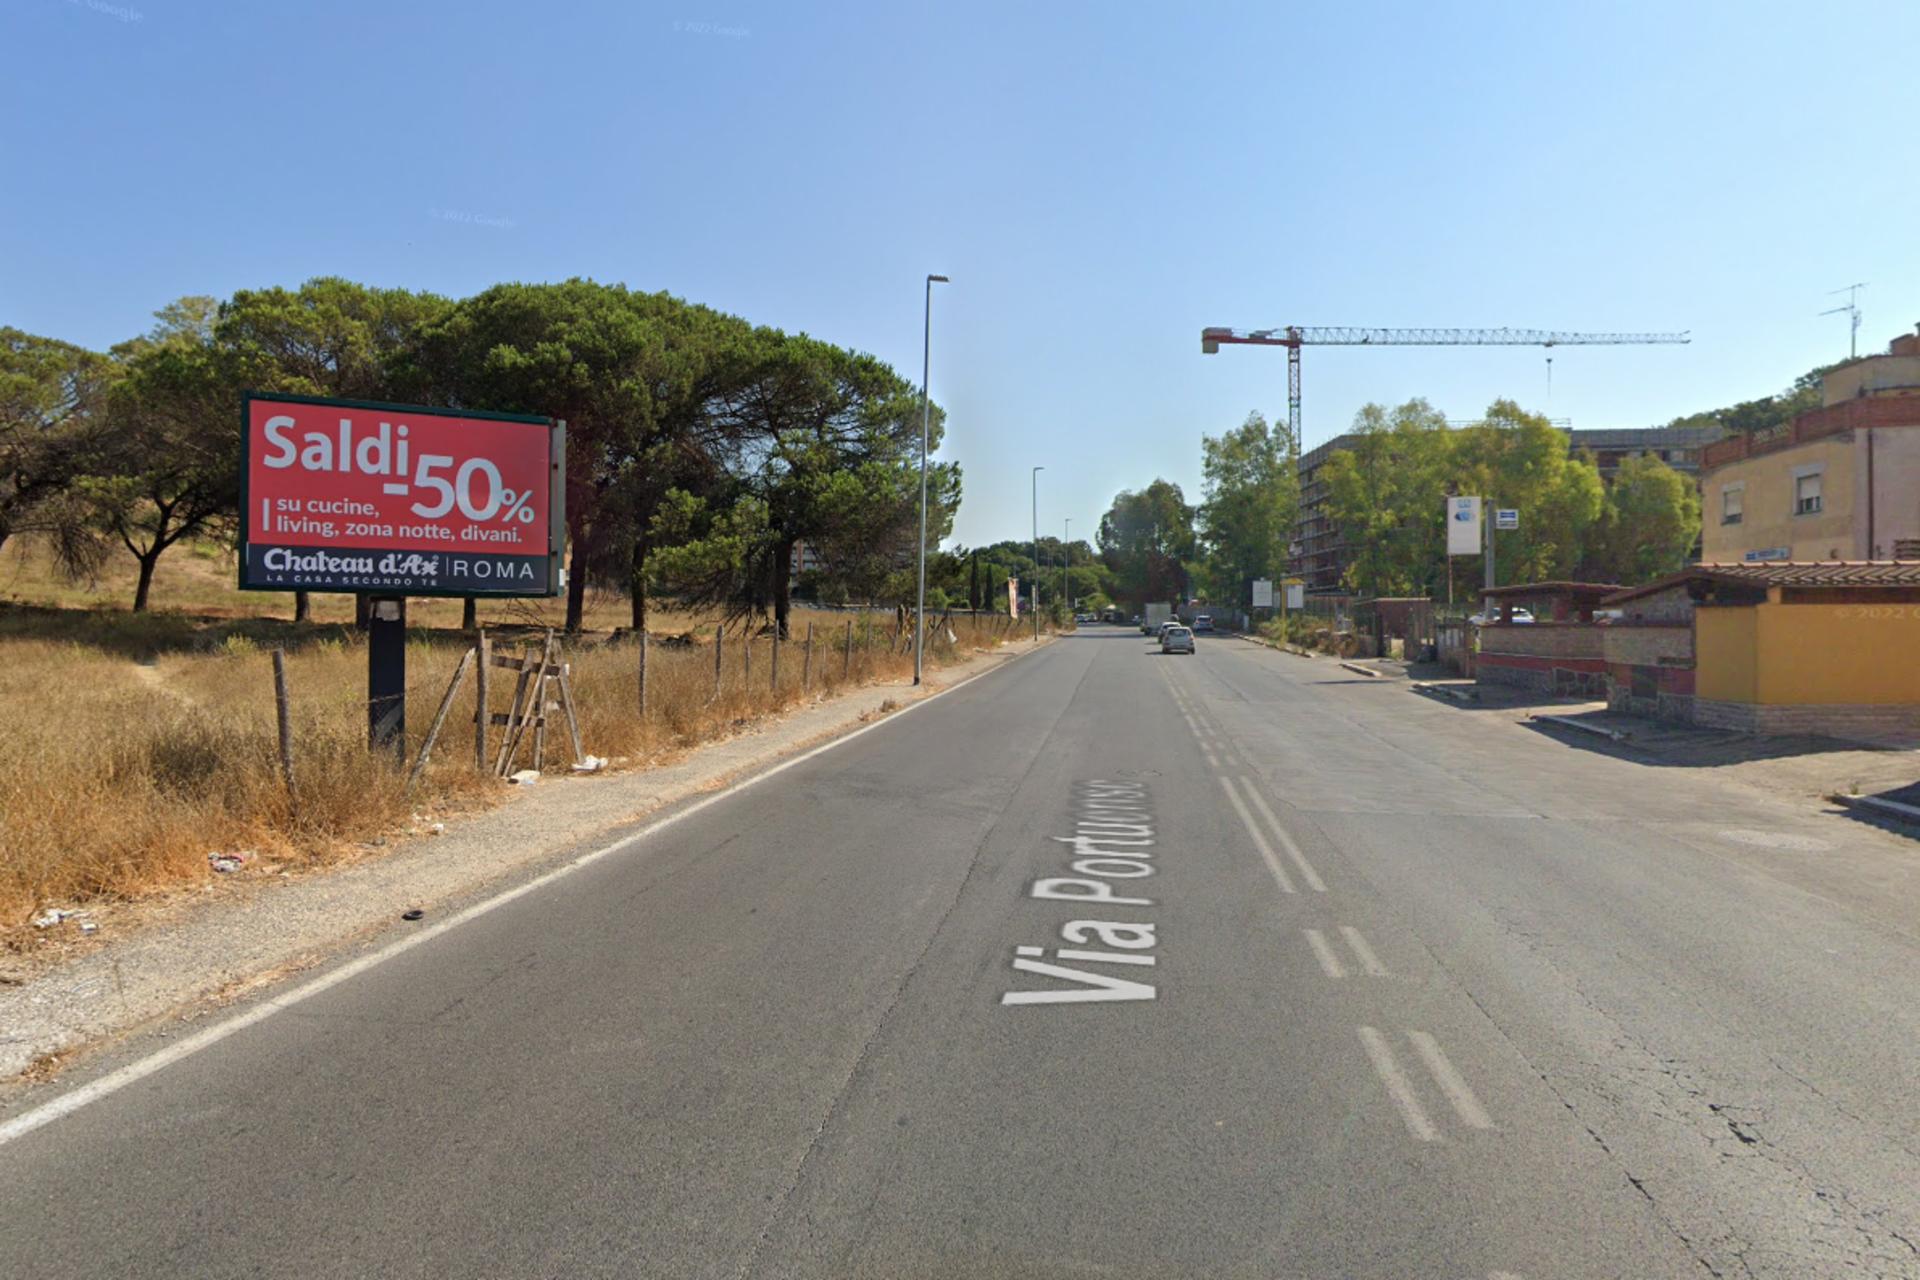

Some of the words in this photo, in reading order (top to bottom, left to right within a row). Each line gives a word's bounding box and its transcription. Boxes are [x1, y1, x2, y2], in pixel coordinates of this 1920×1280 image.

[263, 415, 409, 477] Saldi
[383, 454, 535, 524] -50%
[277, 498, 300, 512] su
[307, 498, 380, 519] cucine,
[277, 515, 340, 538] living,
[345, 522, 393, 538] zona
[399, 524, 456, 541] notte,
[461, 524, 523, 543] divani.
[264, 548, 374, 574] Chateau
[453, 559, 535, 580] ROMA
[266, 575, 284, 583] LA
[294, 575, 333, 584] CASA
[342, 576, 413, 586] SECONDO
[421, 578, 438, 587] TE
